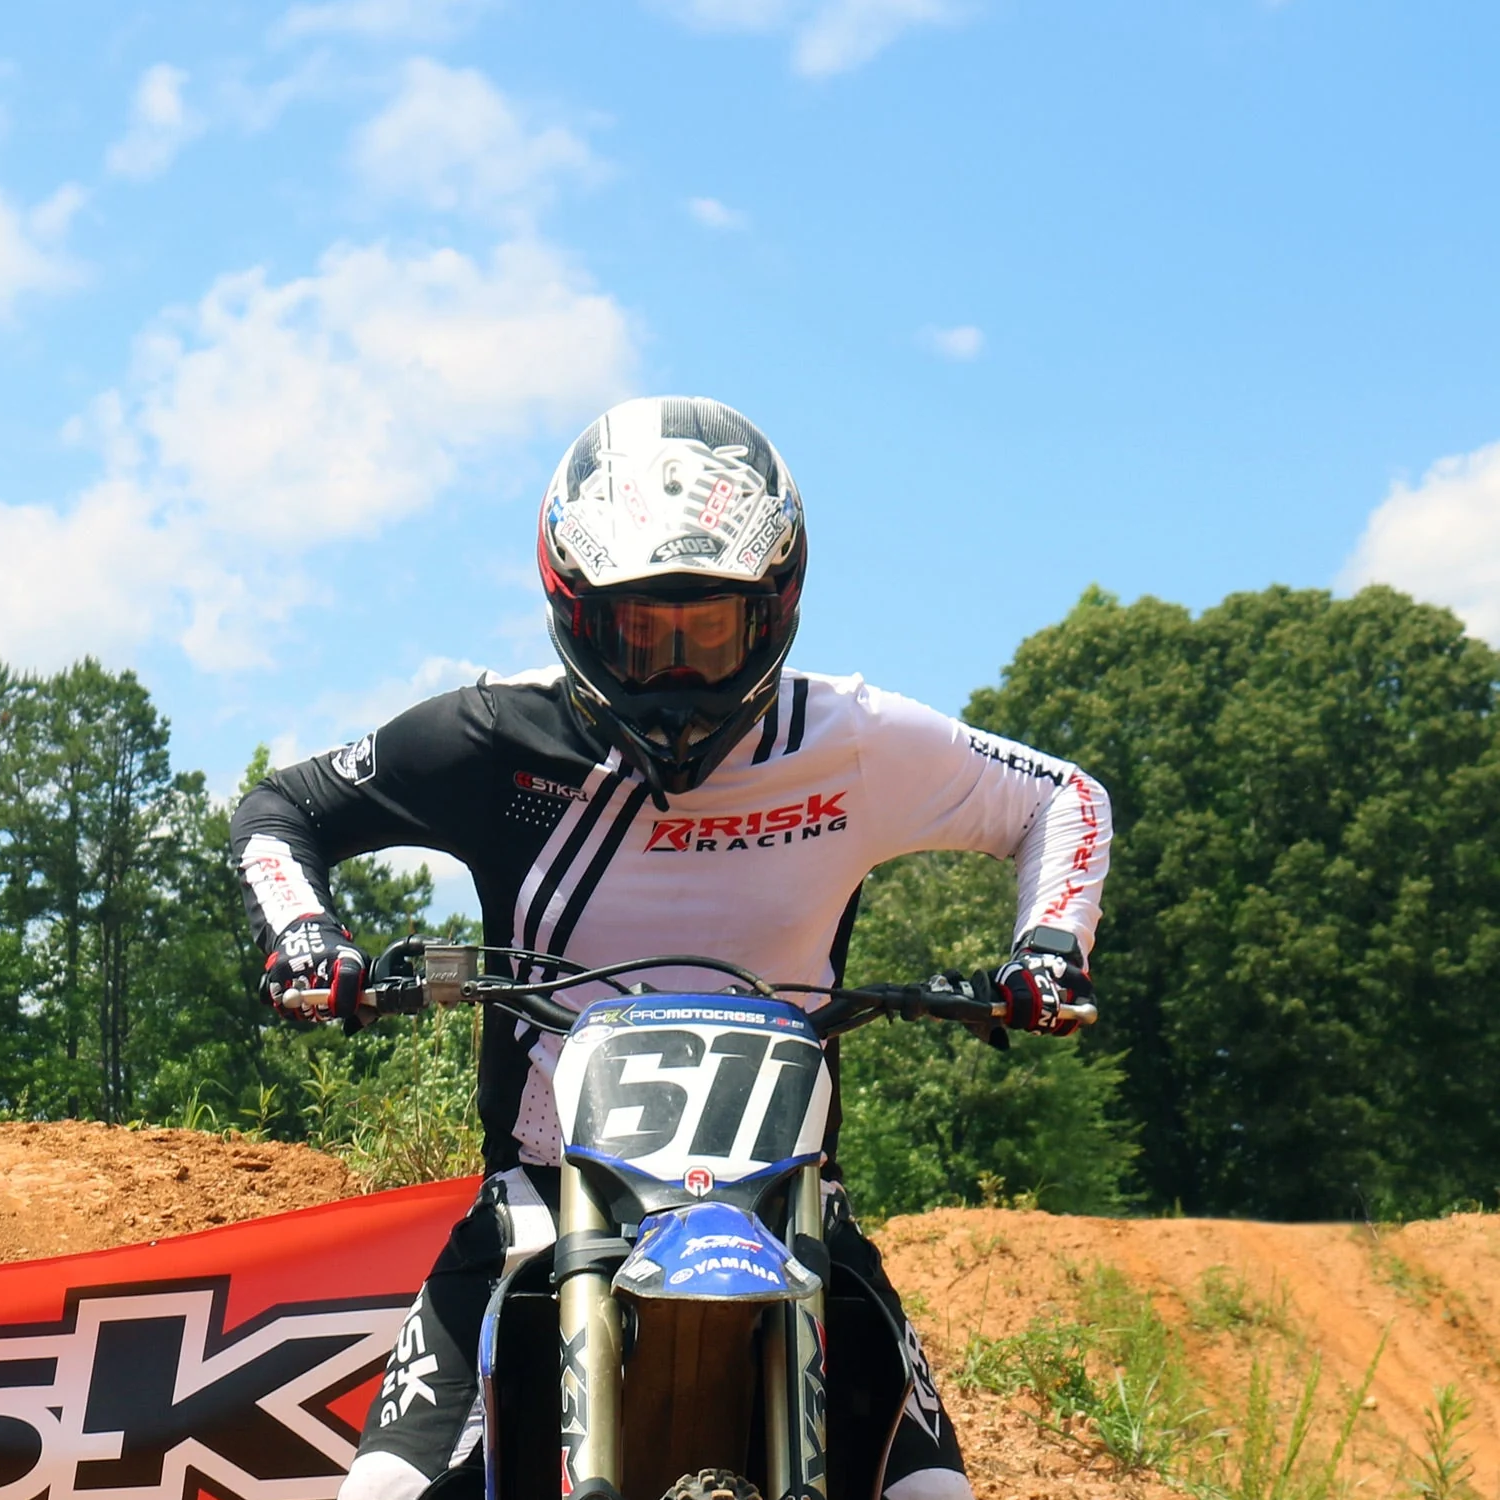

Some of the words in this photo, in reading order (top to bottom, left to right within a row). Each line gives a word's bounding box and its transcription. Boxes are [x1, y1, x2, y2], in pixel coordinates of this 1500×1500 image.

[658, 535, 719, 562] SHOEI
[531, 778, 588, 800] STKR
[698, 790, 849, 838] RISK
[697, 815, 848, 854] RACING
[693, 1256, 781, 1285] YAMAHA
